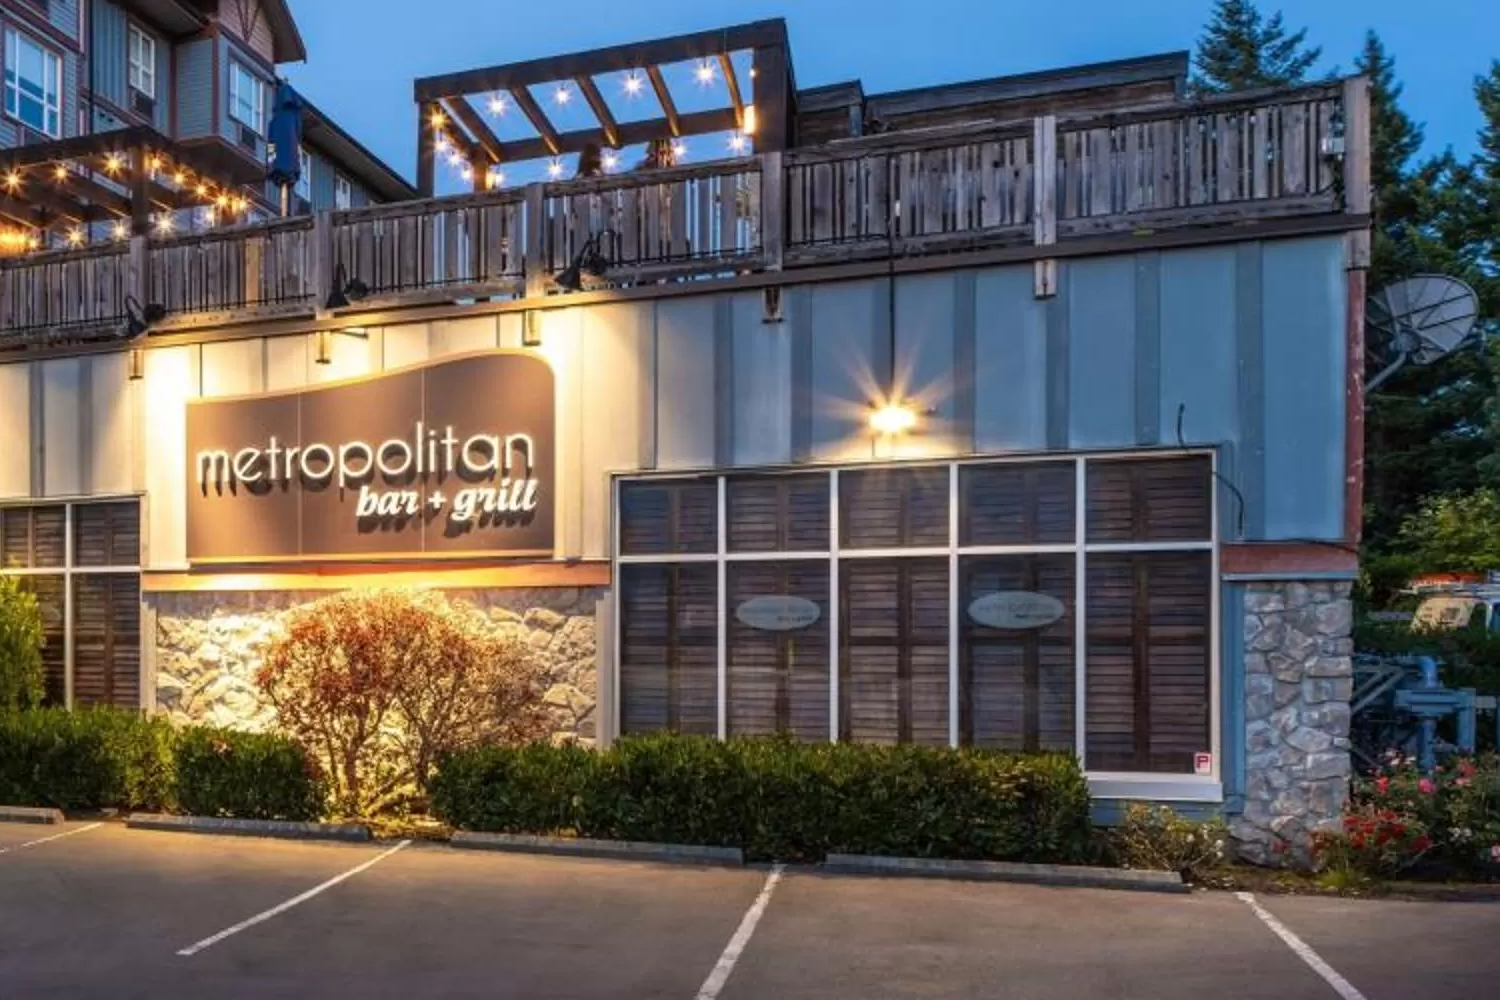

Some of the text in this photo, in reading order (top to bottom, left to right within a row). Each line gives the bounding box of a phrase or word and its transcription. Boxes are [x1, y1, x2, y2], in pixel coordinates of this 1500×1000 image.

[196, 421, 534, 488] metropolitan
[355, 485, 419, 517] bar
[450, 478, 539, 521] grill
